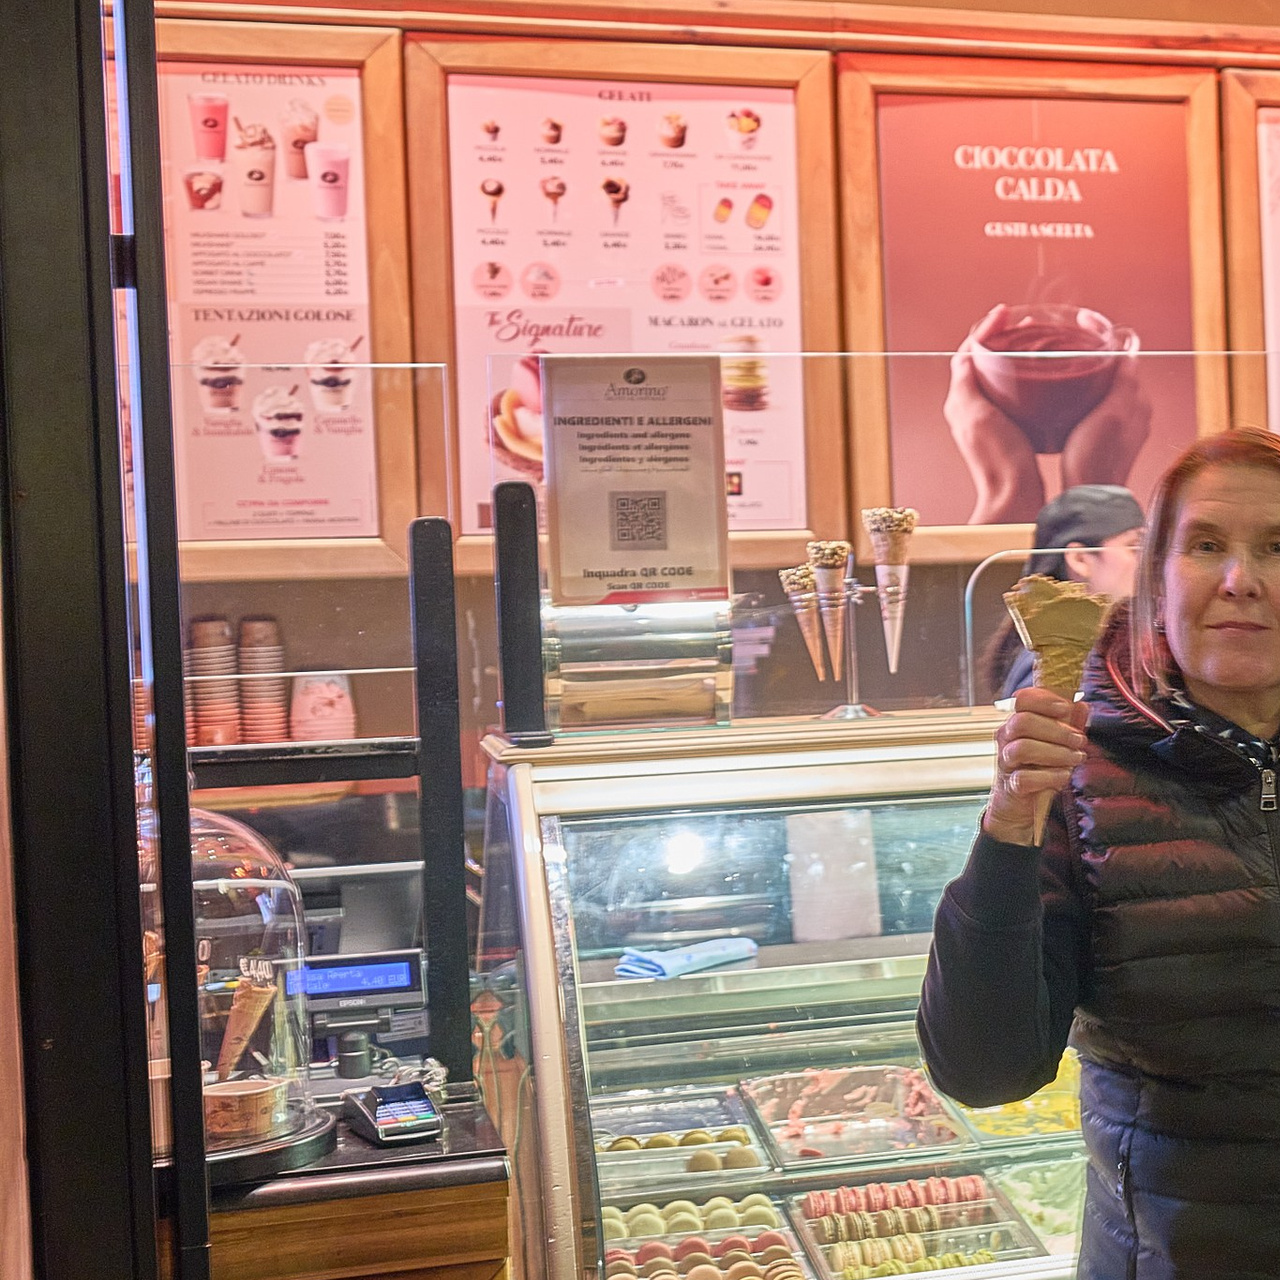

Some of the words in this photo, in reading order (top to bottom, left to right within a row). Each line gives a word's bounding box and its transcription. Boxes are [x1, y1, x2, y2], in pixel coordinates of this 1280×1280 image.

[598, 89, 652, 101] GELATI
[953, 144, 1120, 173] CIOCCOLATA
[994, 176, 1084, 202] CALDA
[192, 309, 290, 321] TENTAZIONI
[495, 308, 604, 347] Signature
[605, 382, 666, 397] Amorino
[553, 416, 634, 426] INGREDIENTI
[637, 416, 644, 426] E
[648, 416, 713, 426] ALLERGENI
[582, 568, 637, 580] Inquadra
[640, 567, 658, 577] QR
[661, 566, 694, 576] CODE
[339, 998, 365, 1007] EPSON
